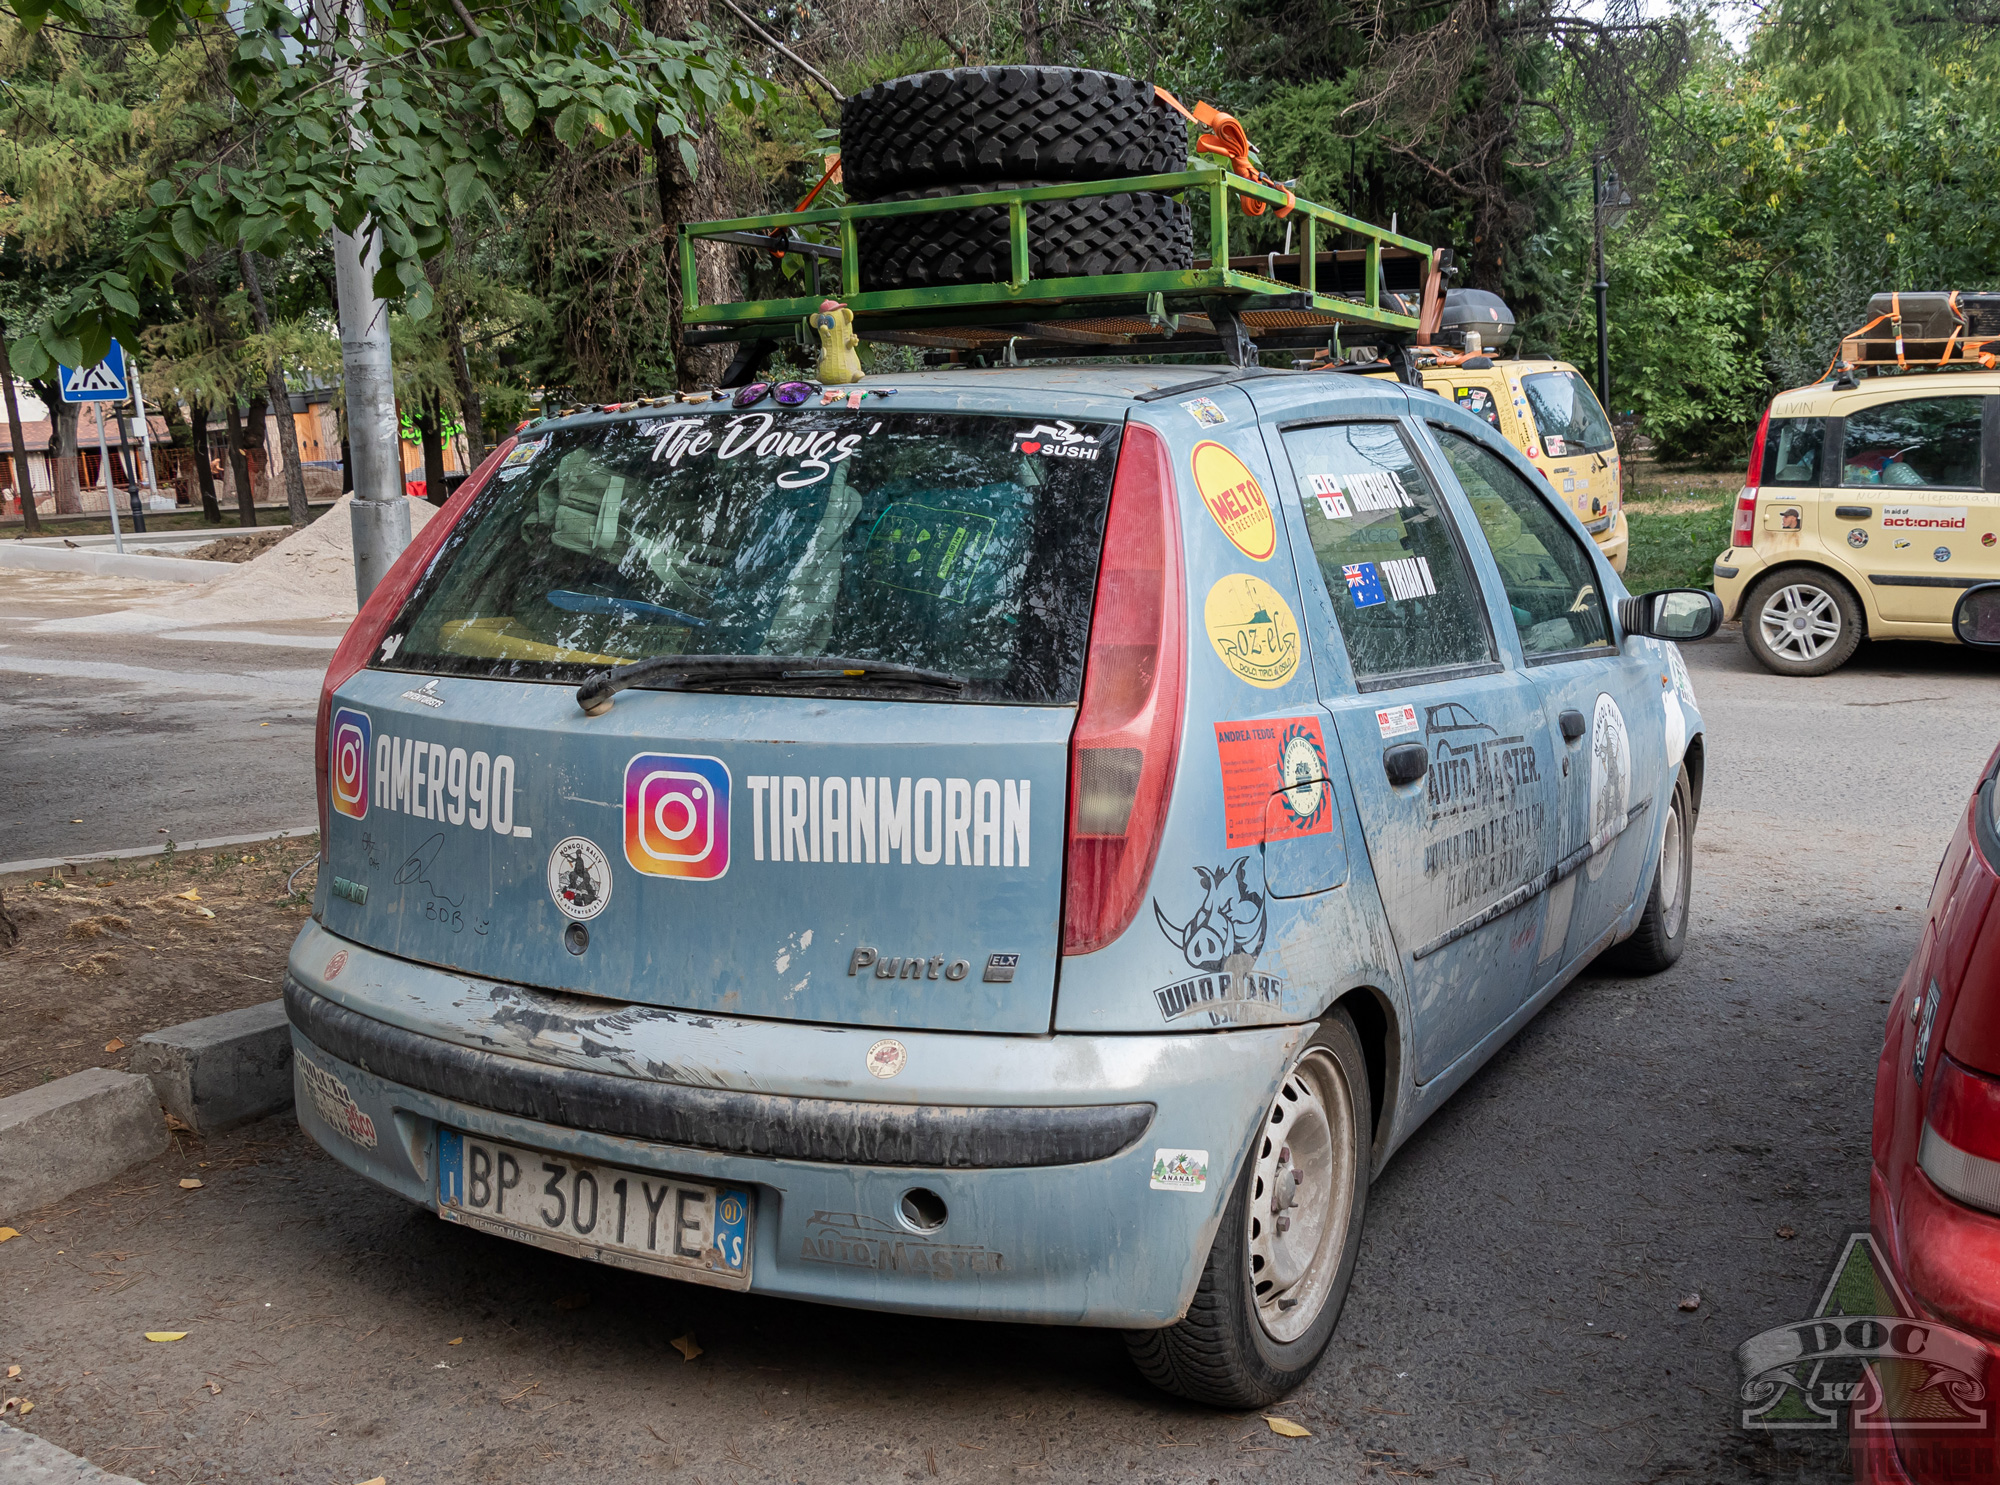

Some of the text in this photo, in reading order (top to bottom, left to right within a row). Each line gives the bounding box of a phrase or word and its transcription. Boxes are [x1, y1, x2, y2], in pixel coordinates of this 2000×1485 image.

[644, 417, 713, 468] The
[1011, 442, 1099, 461] I SUSHI
[1209, 479, 1262, 525] MELTO
[1342, 471, 1403, 513] AMERIGO
[1227, 514, 1268, 537] STREETFOOD
[1239, 662, 1258, 677] DOLCI
[1257, 667, 1274, 678] TIPICI
[1278, 657, 1292, 675] OSILO
[1218, 728, 1276, 743] ANDREA TEDDE
[374, 733, 533, 839] AMER990_
[746, 774, 1031, 868] TIRIANMORAN
[559, 843, 603, 864] MONGOL RALLY
[847, 946, 1018, 982] Punto ELX
[468, 1142, 520, 1215] BP
[1161, 1174, 1195, 1182] ANANAS
[723, 1203, 739, 1221] 01
[716, 1232, 743, 1267] SS
